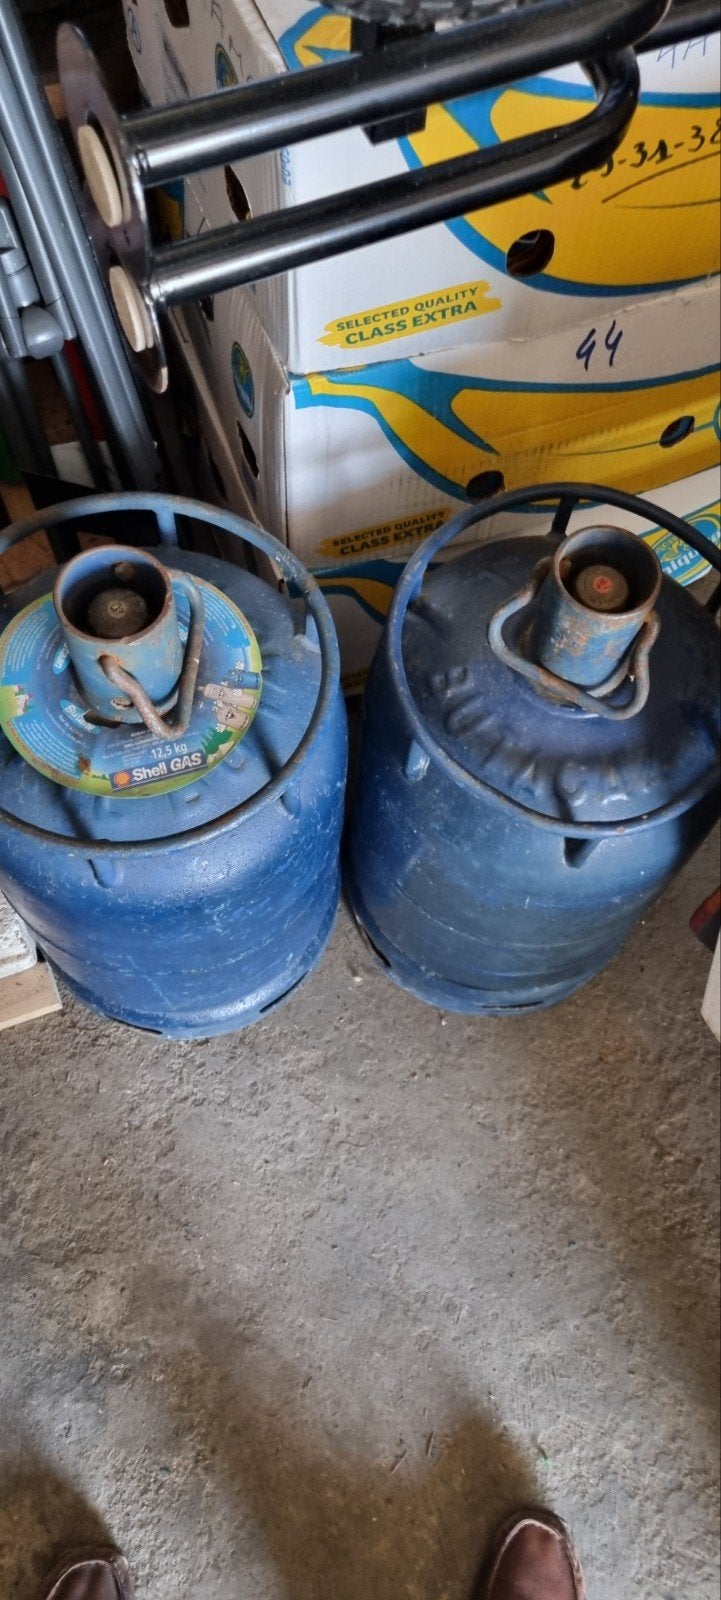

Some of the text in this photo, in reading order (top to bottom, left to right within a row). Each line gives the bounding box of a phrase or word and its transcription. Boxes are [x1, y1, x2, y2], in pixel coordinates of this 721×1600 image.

[336, 286, 479, 332] SELECTED QUALITY
[345, 300, 478, 345] CLASS EXTRA
[332, 510, 446, 547] SELECTED QUALITY
[340, 536, 390, 556] CLASS
[131, 752, 202, 782] Shell GAS
[151, 743, 188, 760] 12,5 kg
